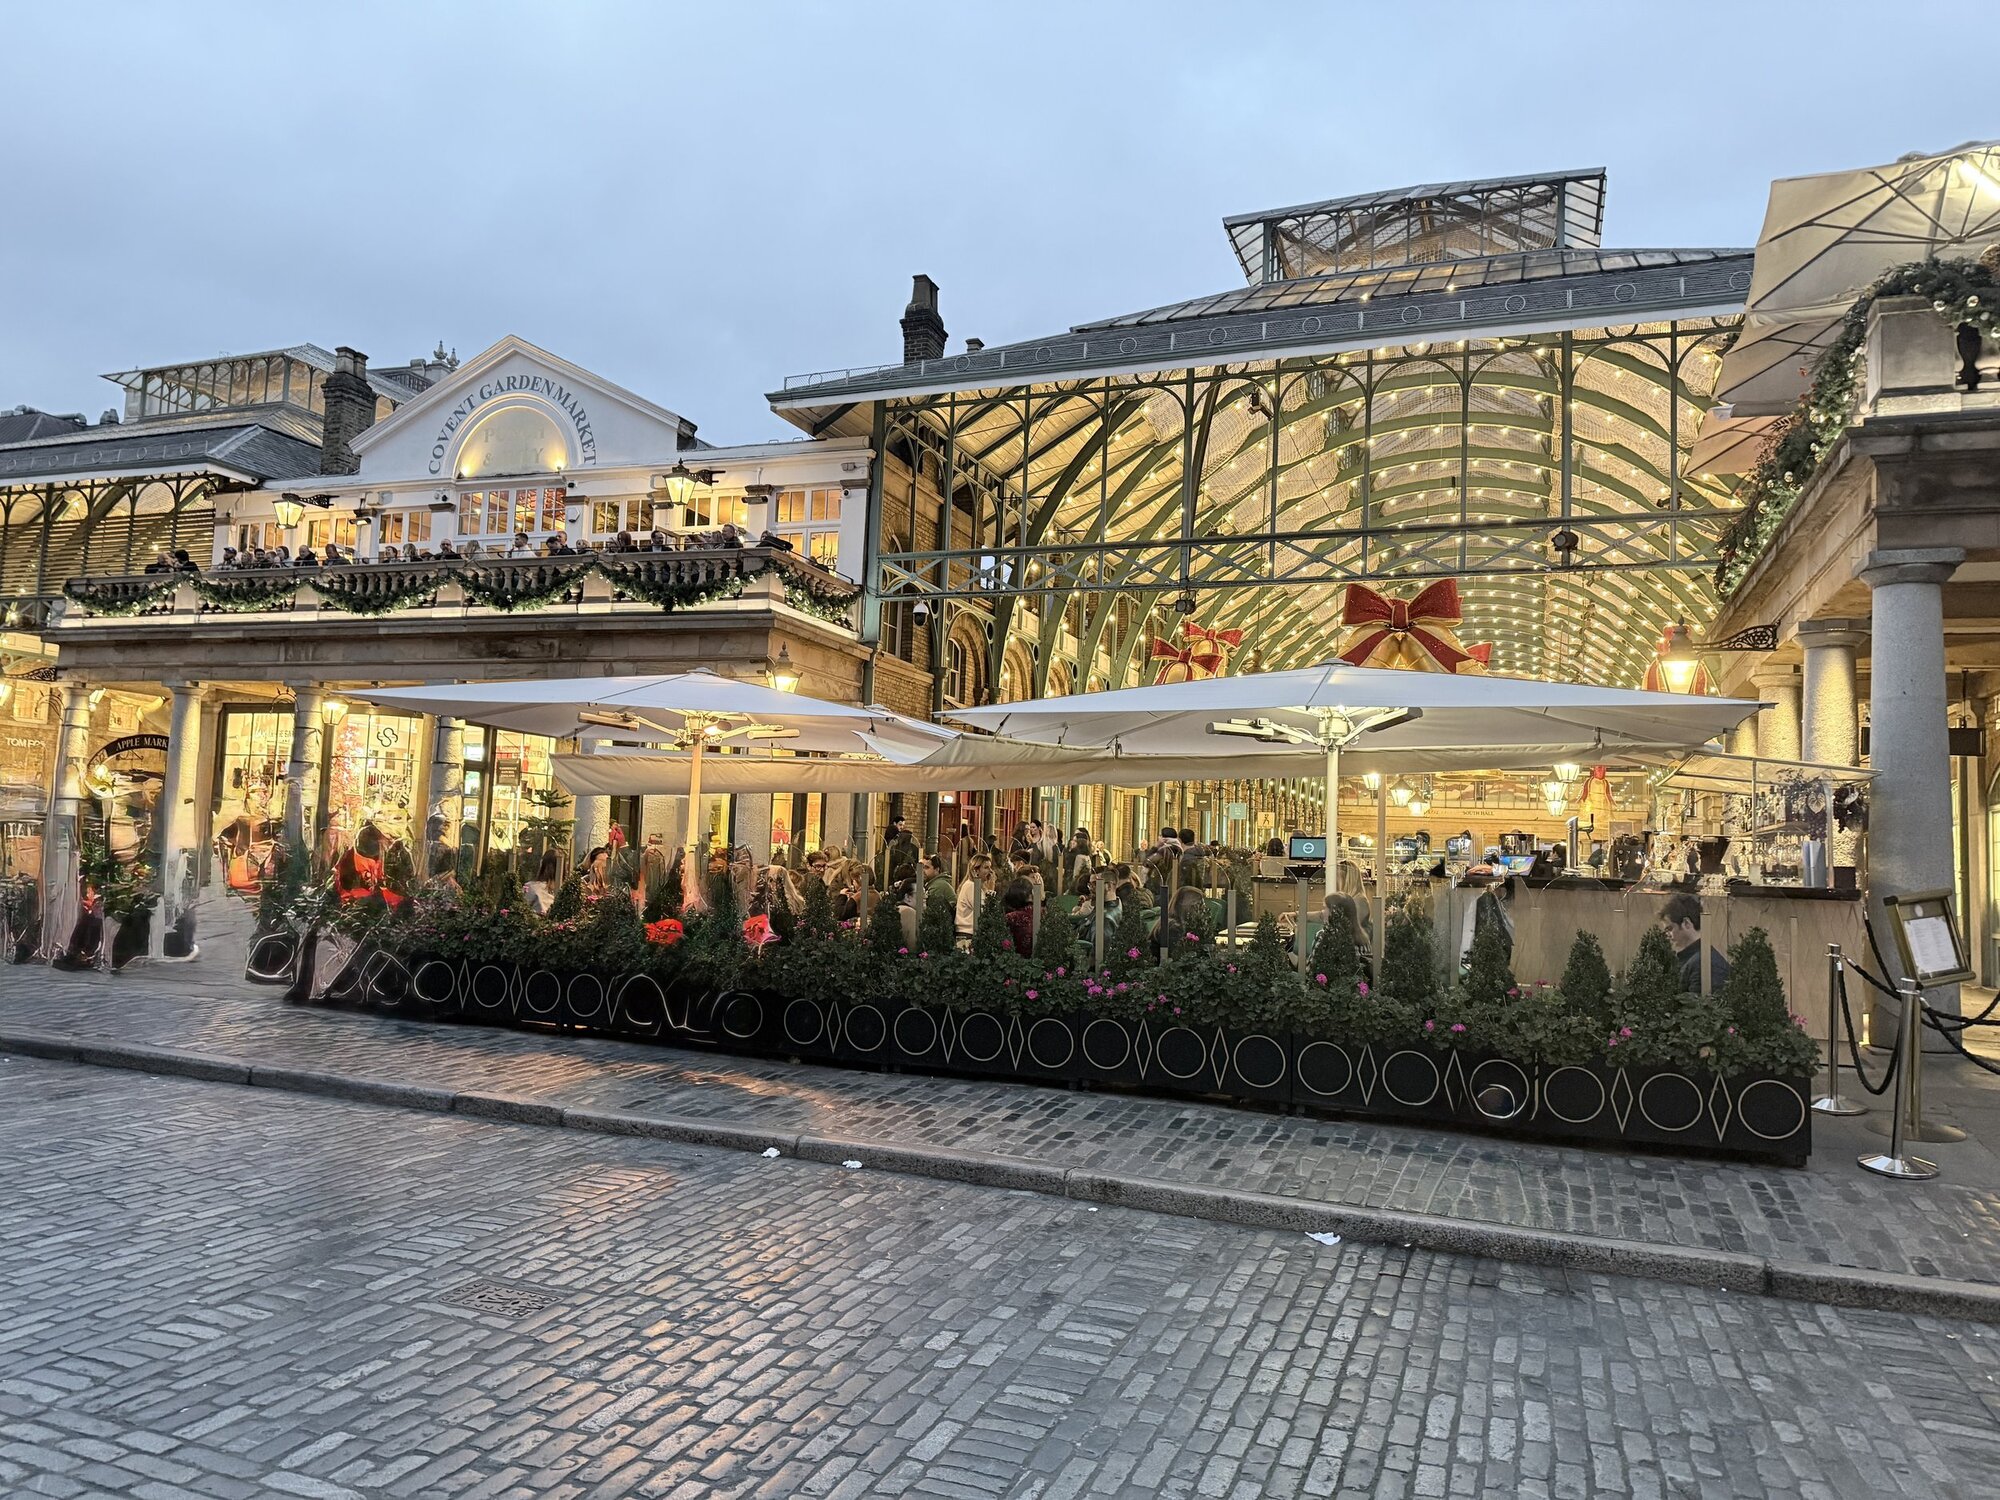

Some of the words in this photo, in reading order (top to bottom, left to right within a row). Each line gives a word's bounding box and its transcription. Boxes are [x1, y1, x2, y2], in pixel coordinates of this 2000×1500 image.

[428, 393, 476, 475] COVENT
[479, 374, 556, 401] GARDEN
[552, 386, 598, 465] MARKET
[5, 737, 27, 748] TOM
[116, 737, 140, 752] APPLE
[144, 737, 168, 748] MARK
